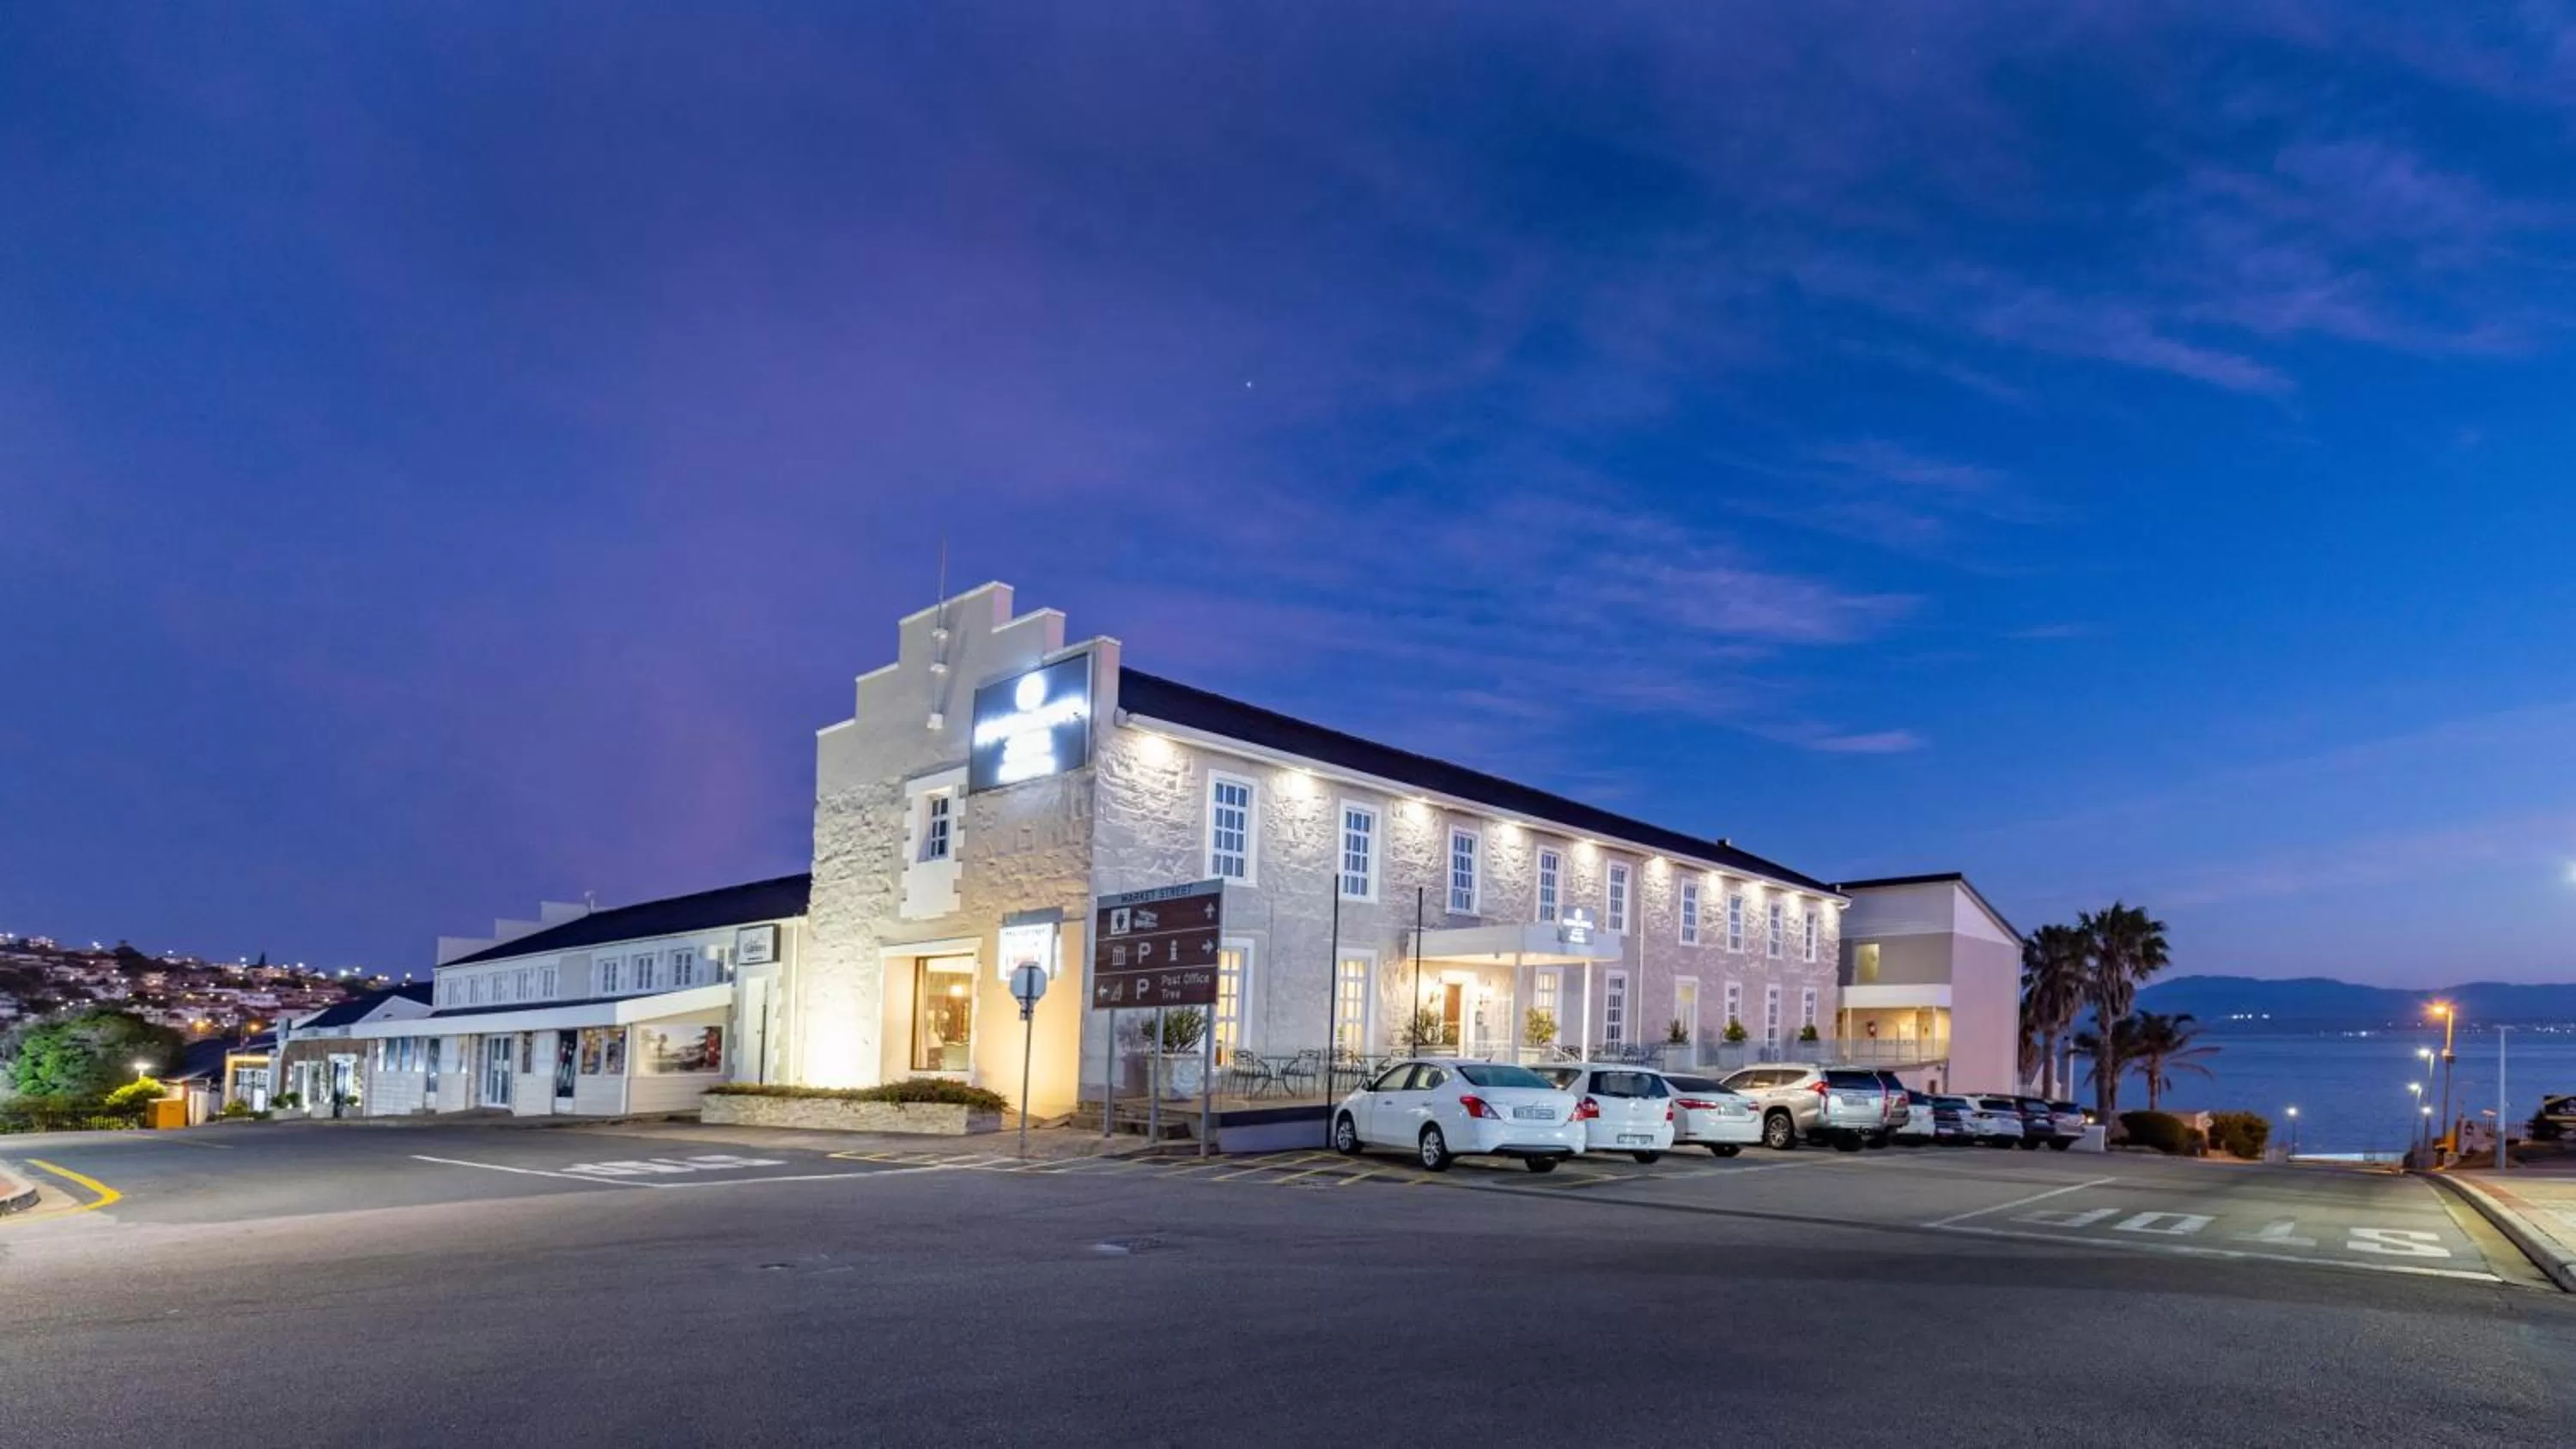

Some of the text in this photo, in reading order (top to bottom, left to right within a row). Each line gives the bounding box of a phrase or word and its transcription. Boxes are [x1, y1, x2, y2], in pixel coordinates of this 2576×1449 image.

[1121, 884, 1193, 903] MARKET STREET
[1138, 942, 1151, 965] P
[1136, 978, 1150, 1000] P
[1160, 972, 1210, 986] Post Office
[1161, 988, 1181, 1001] Tree
[2009, 1207, 2451, 1258] STOP
